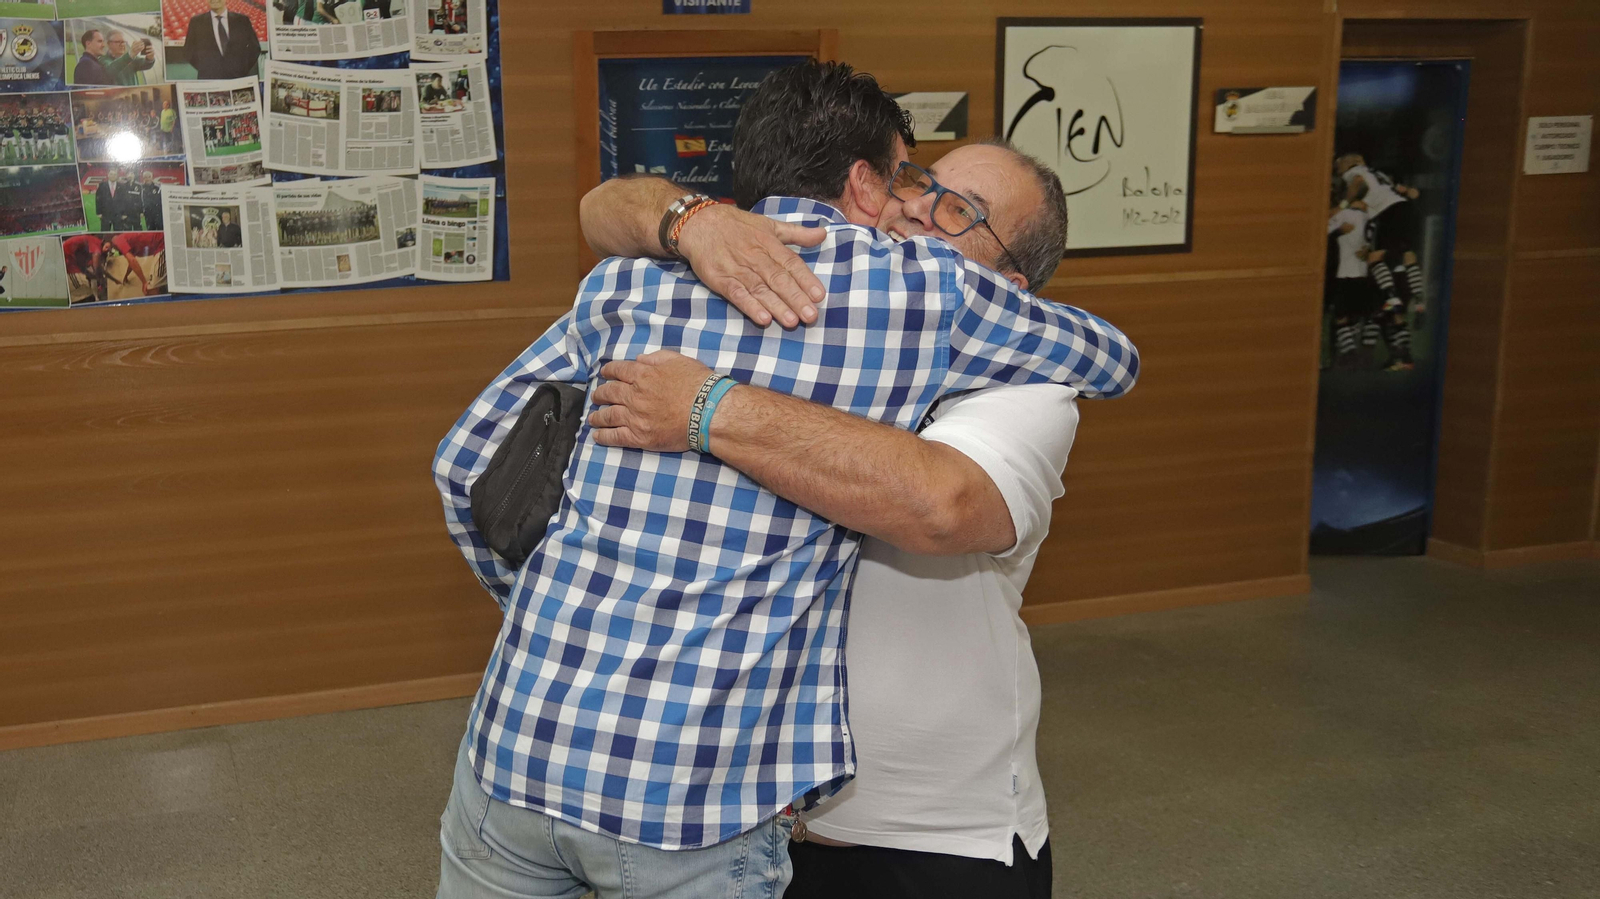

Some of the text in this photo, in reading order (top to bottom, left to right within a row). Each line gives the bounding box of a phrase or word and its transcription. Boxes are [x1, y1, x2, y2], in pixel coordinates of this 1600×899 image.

[638, 78, 658, 91] Un
[662, 71, 705, 91] Estadio
[708, 81, 726, 90] con
[599, 99, 618, 139] balona
[707, 139, 734, 163] Espa
[671, 165, 720, 183] Finlandia
[447, 219, 466, 228] bingo
